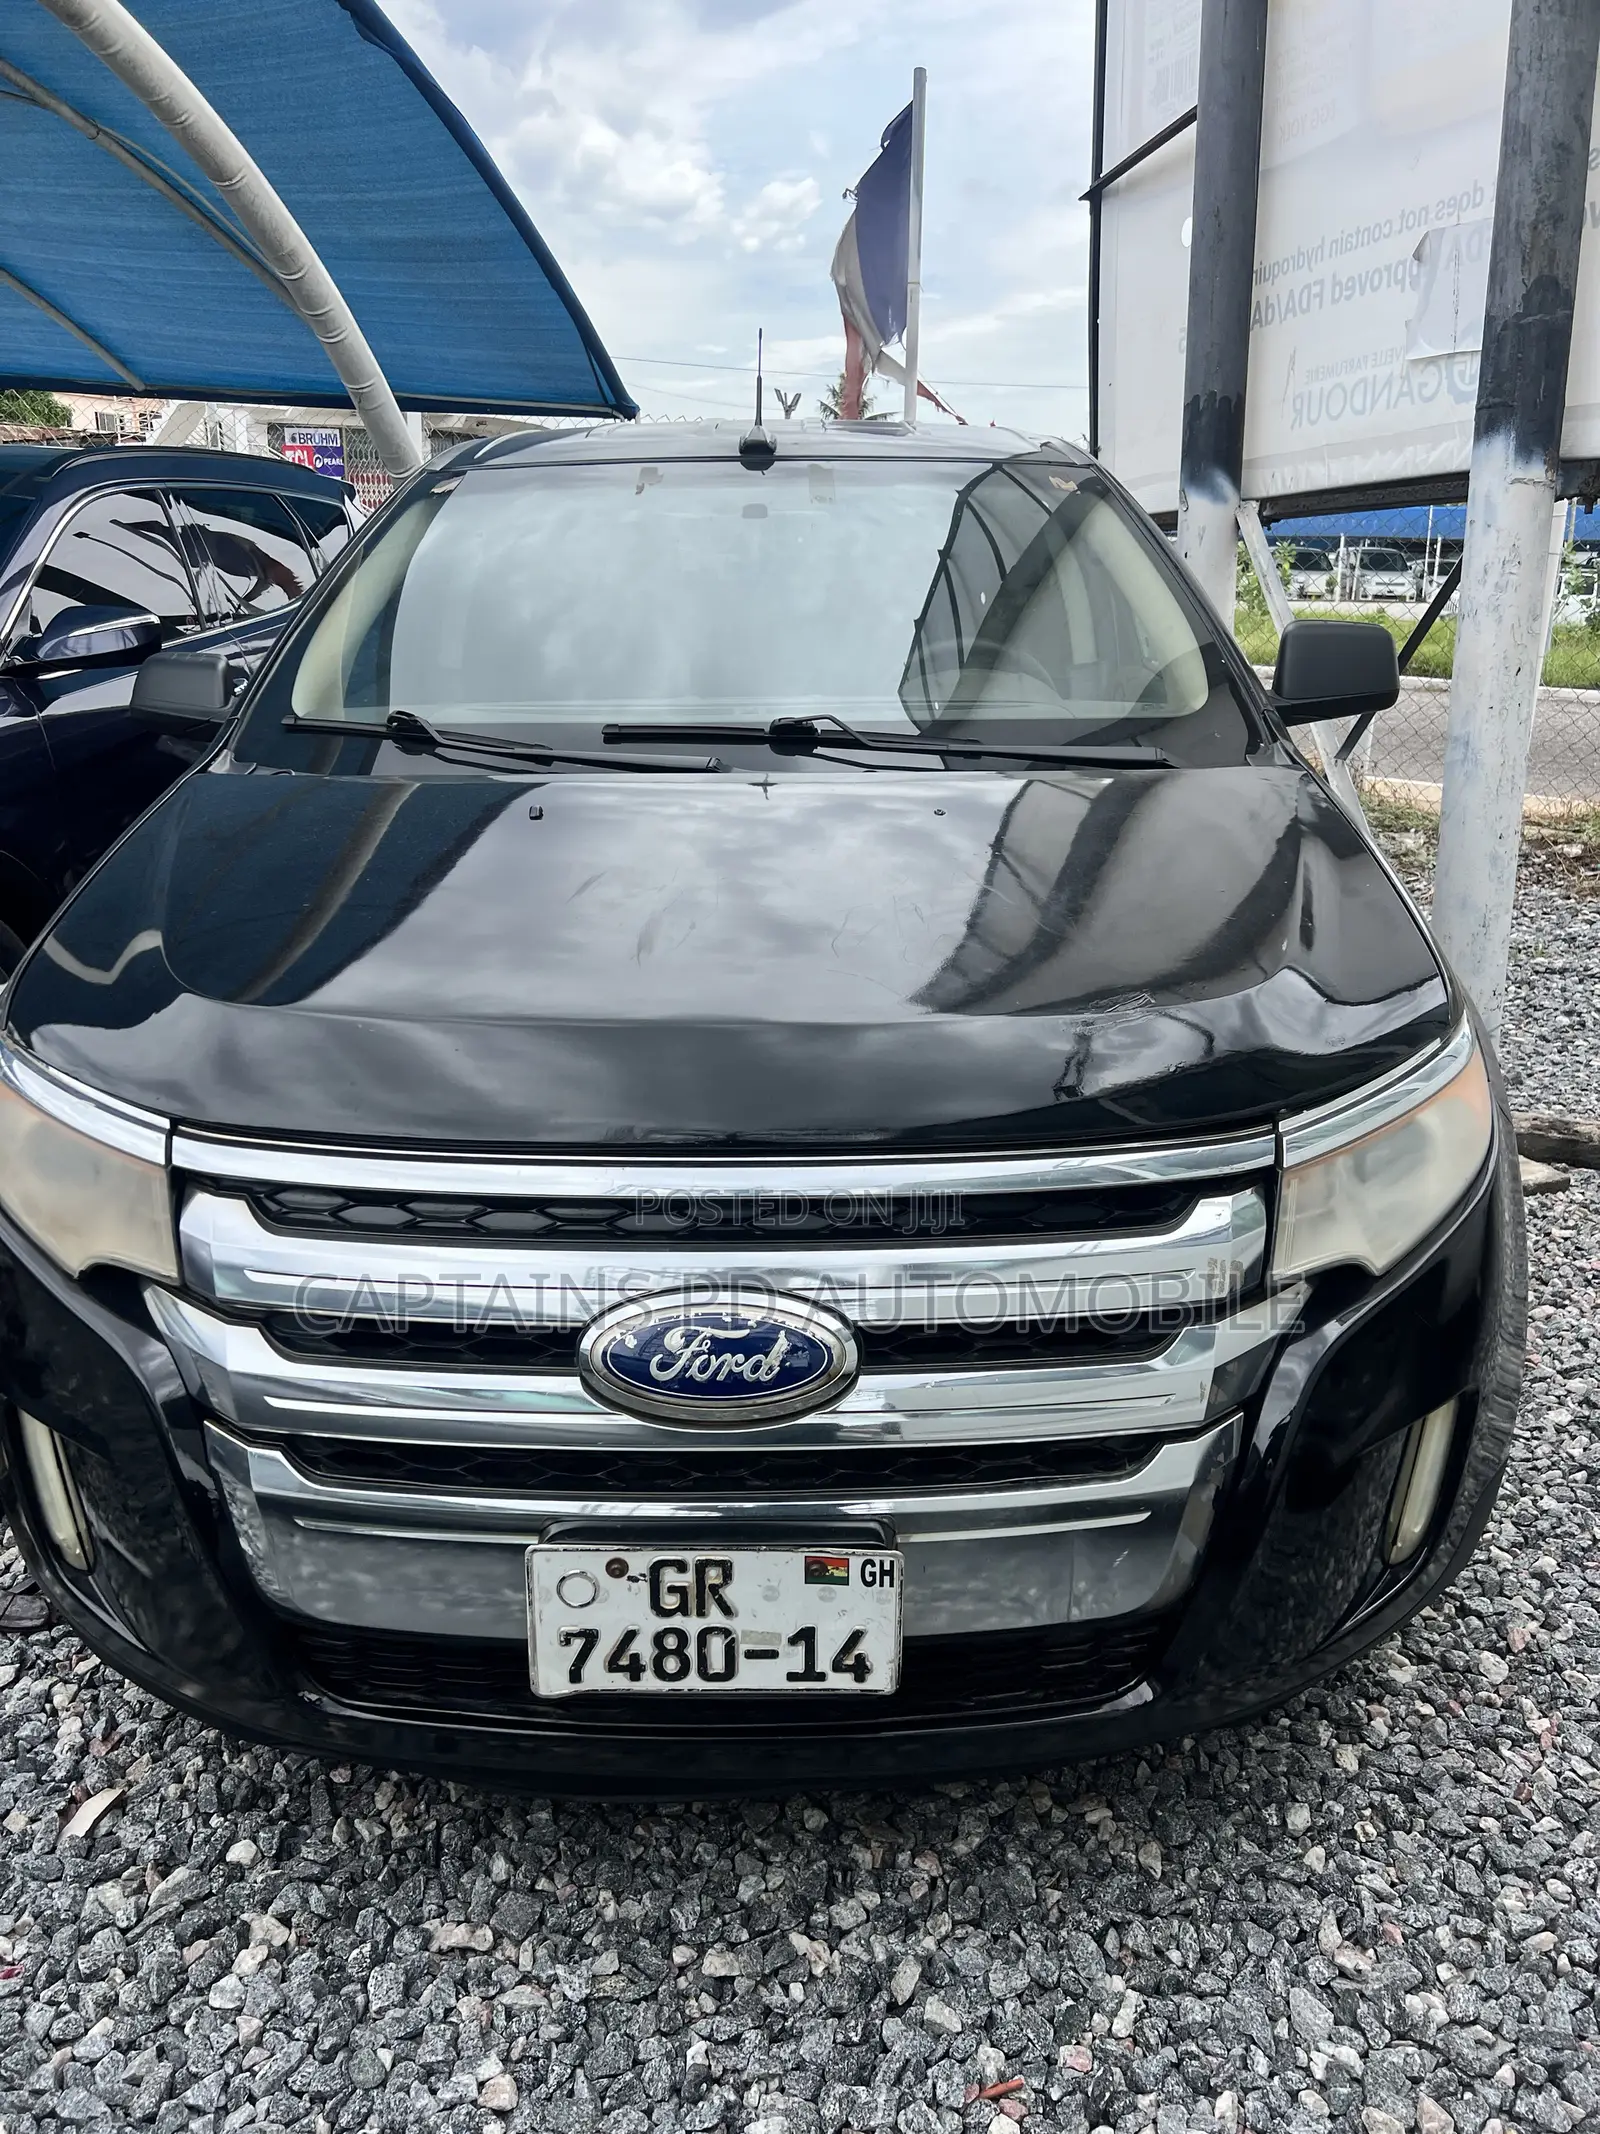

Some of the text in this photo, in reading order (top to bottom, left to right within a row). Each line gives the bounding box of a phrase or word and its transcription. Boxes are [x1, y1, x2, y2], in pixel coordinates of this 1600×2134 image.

[298, 432, 338, 446] BRUHM
[323, 457, 344, 466] PEARL
[649, 1326, 791, 1383] Ford
[647, 1555, 737, 1619] GR
[860, 1558, 896, 1589] GH
[557, 1624, 875, 1685] 7480-14
